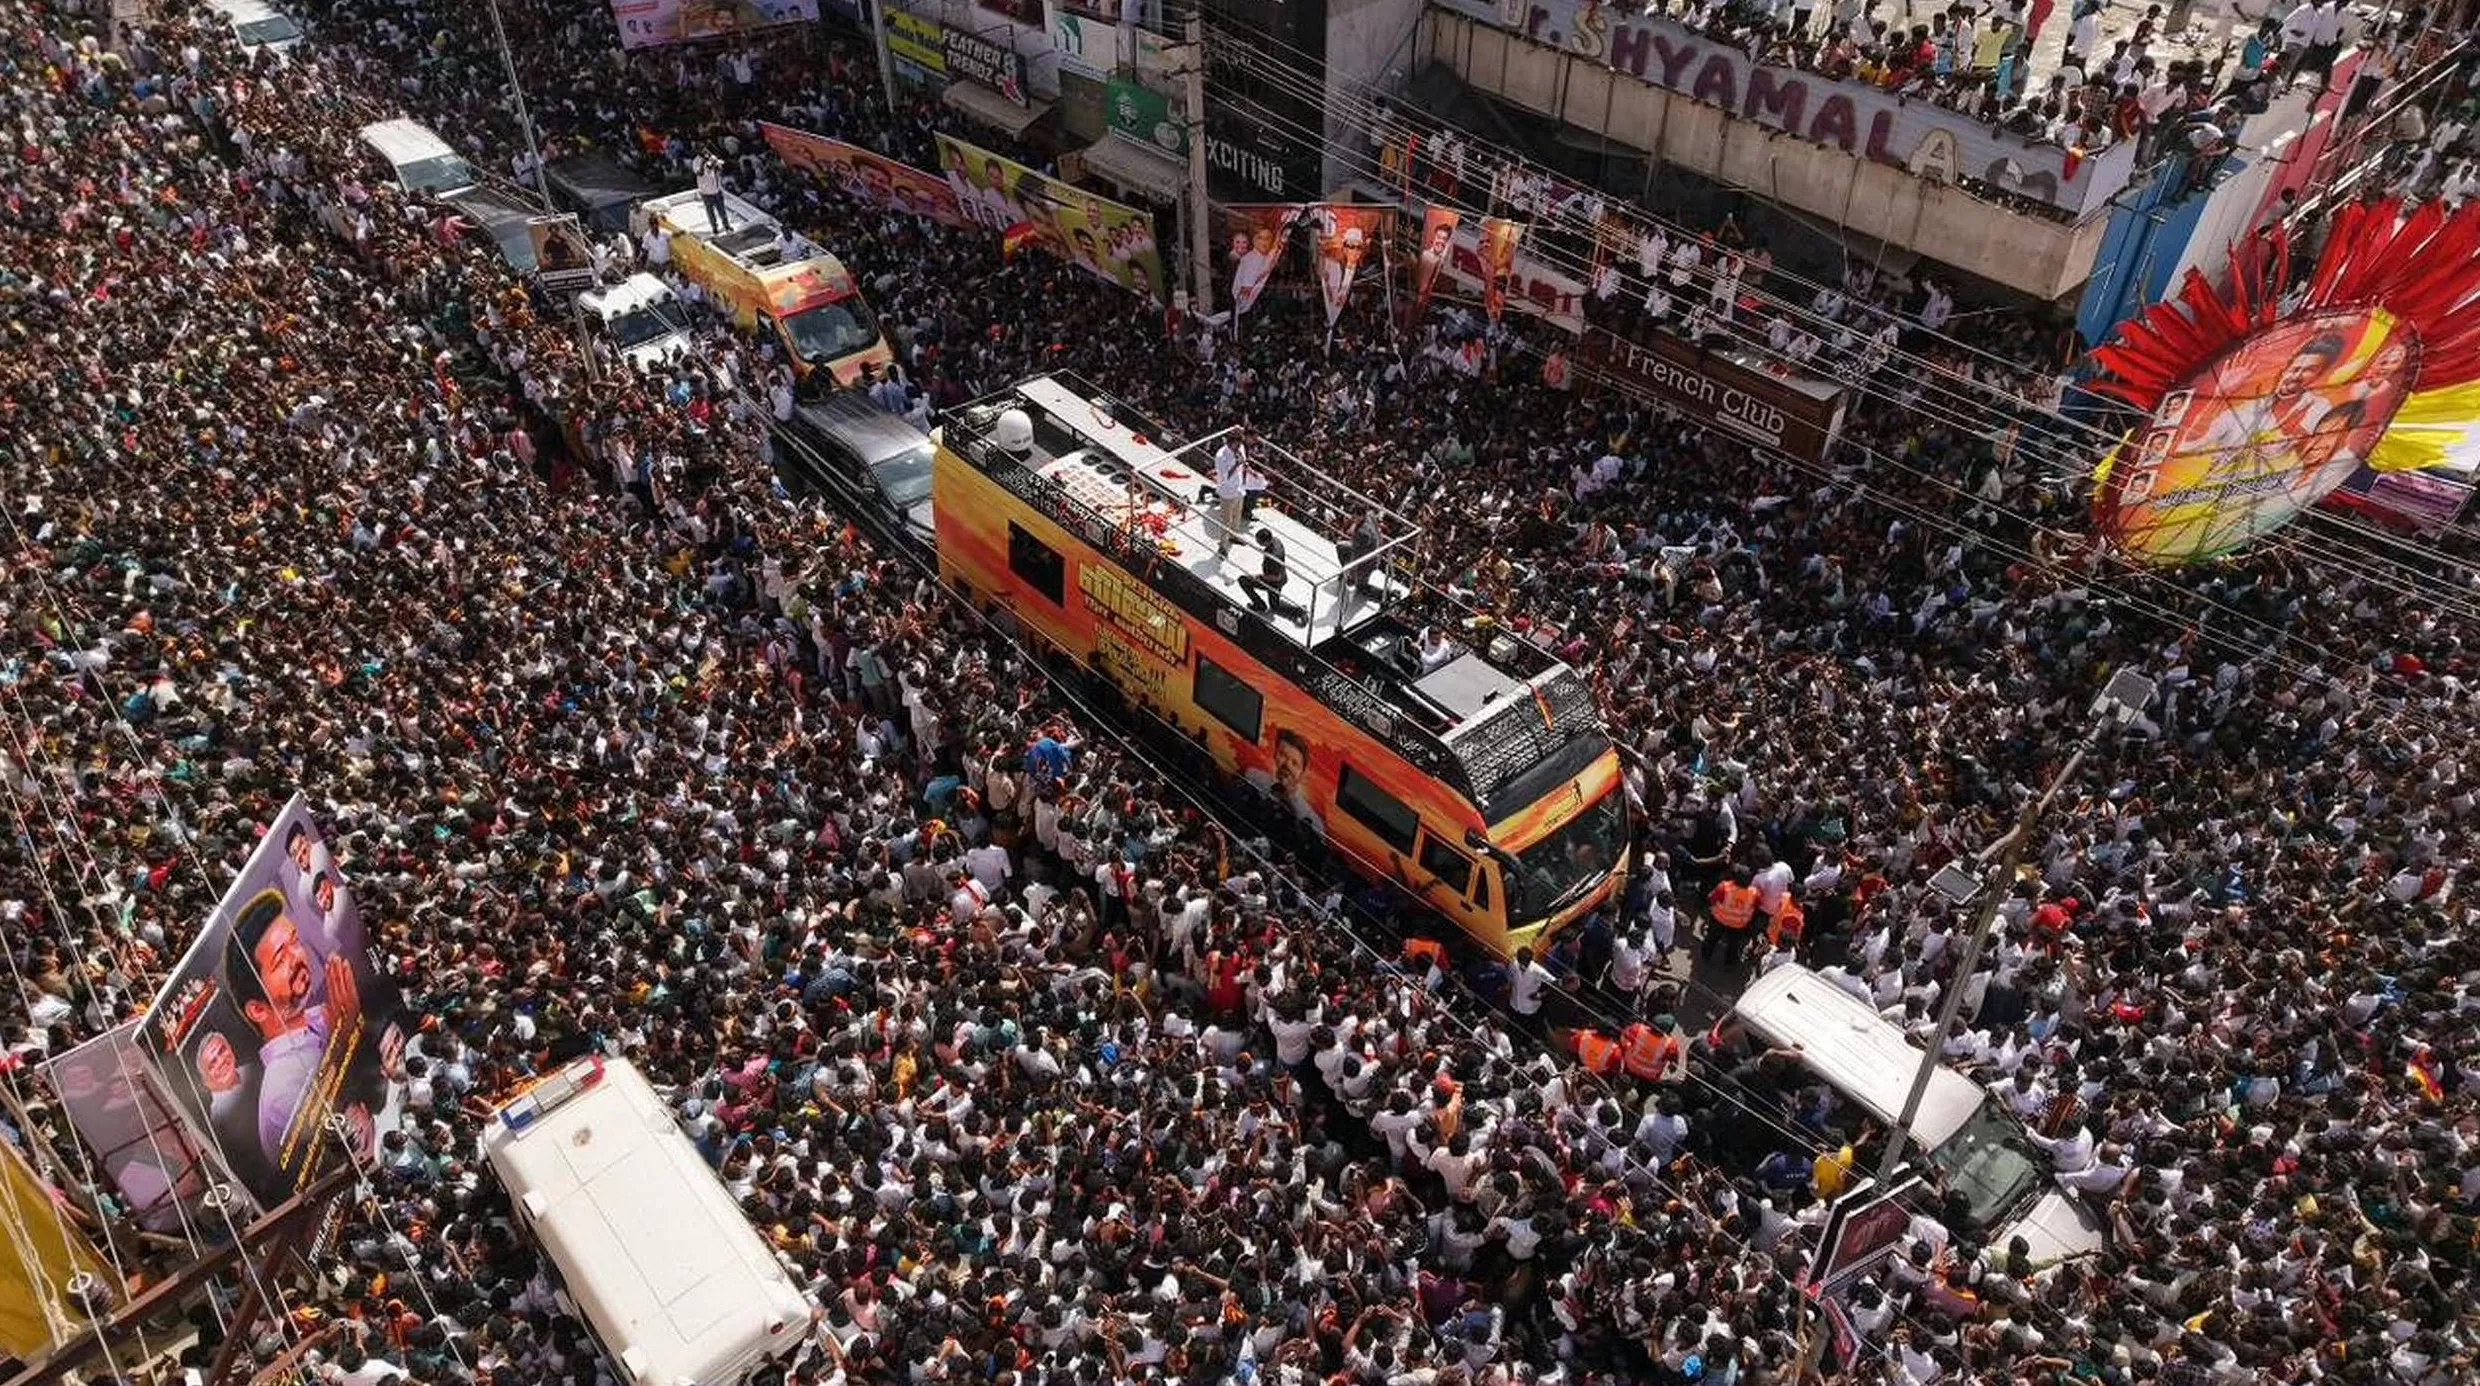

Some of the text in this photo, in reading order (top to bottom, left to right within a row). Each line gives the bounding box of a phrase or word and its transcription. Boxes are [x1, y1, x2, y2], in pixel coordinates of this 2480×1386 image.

[942, 29, 1001, 67] FEATHER
[1206, 135, 1285, 196] XCITING
[1627, 344, 1715, 405] French
[1722, 389, 1786, 435] Club
